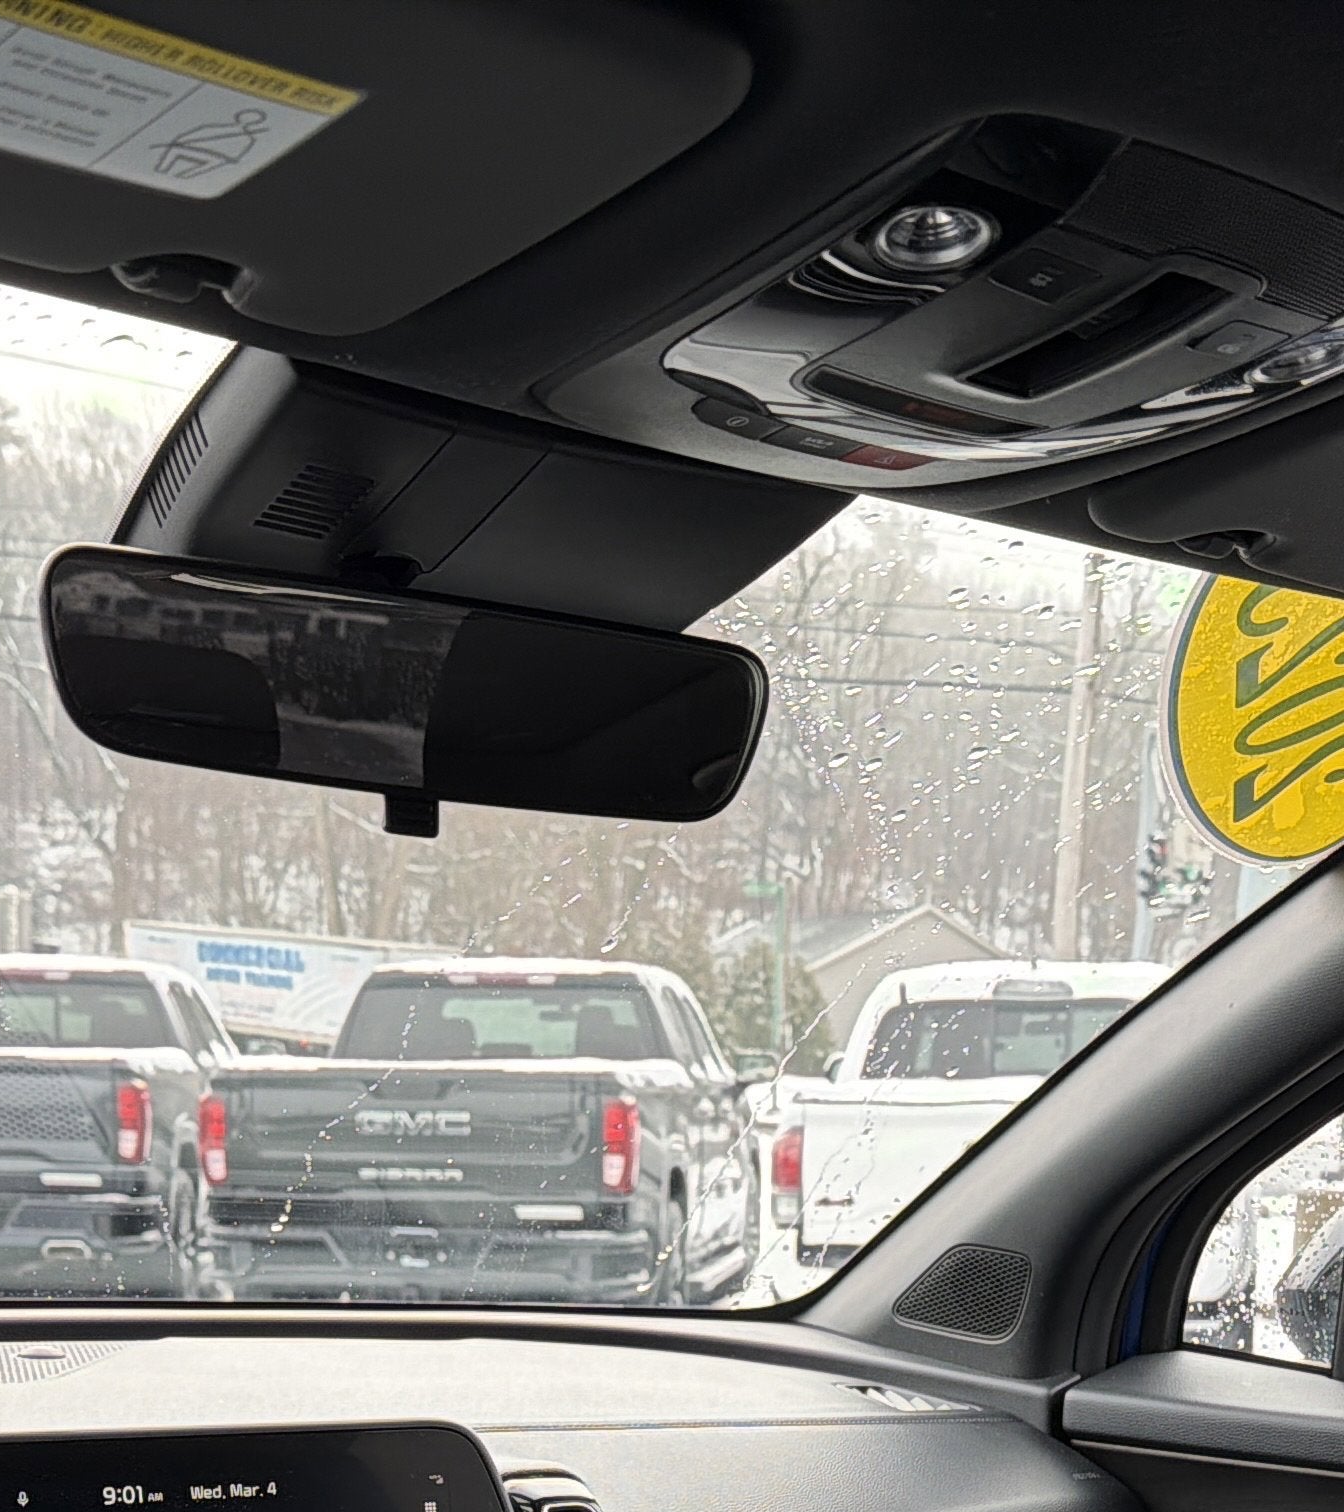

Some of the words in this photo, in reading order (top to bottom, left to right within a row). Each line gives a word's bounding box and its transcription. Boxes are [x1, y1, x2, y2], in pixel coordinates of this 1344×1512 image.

[354, 1110, 472, 1136] GMC
[102, 1486, 144, 1506] 9:01
[147, 1491, 164, 1502] AM
[229, 1482, 263, 1498] Mar.
[267, 1481, 277, 1496] 4
